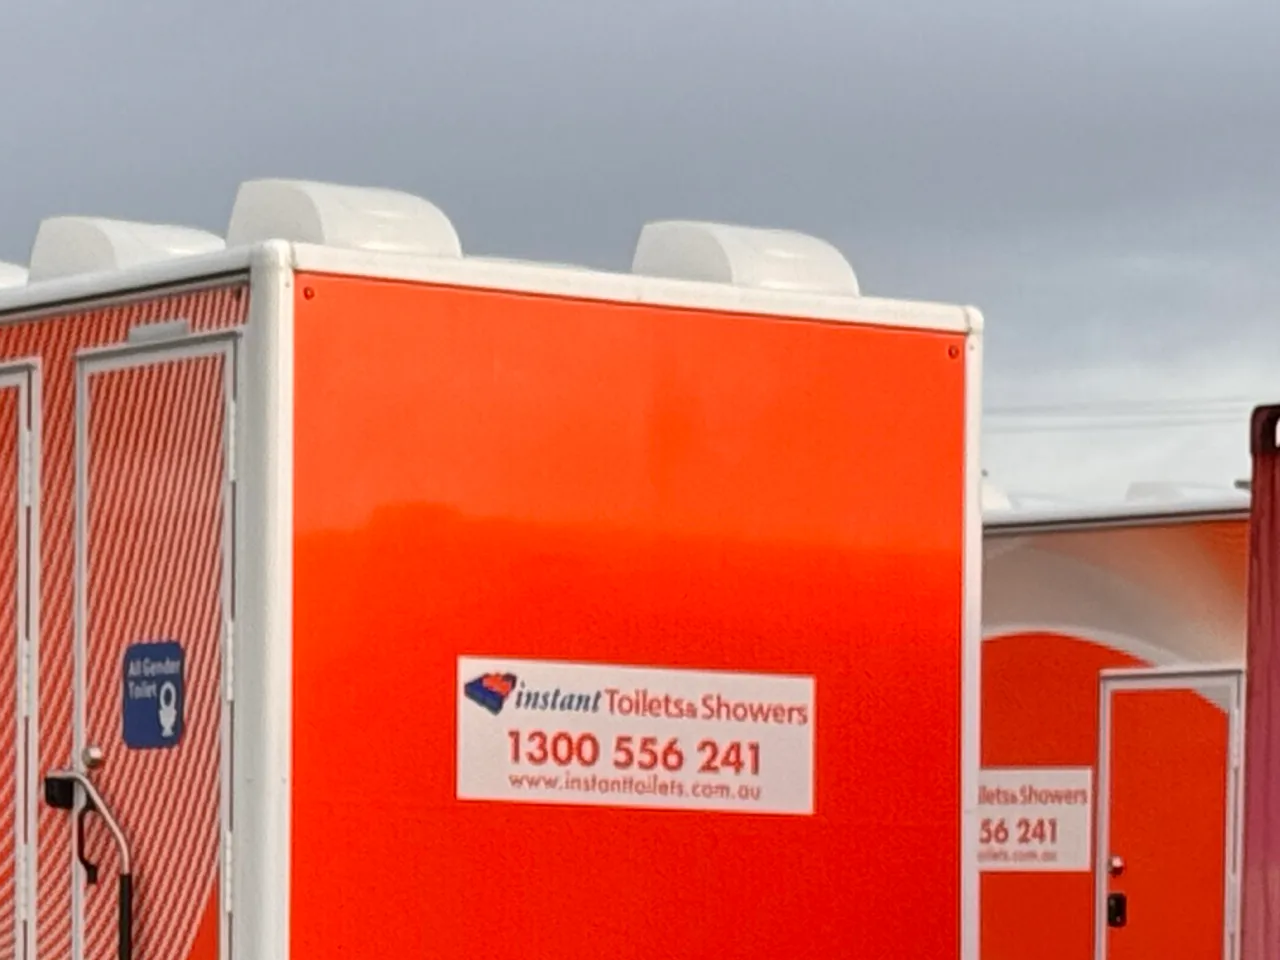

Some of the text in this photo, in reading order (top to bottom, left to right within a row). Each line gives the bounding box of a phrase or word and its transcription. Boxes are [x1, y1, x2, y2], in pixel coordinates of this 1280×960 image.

[516, 679, 602, 713] instant
[508, 729, 761, 776] 1300 556 241
[508, 770, 762, 800] www.instanttoilets.com.au
[1016, 818, 1057, 845] 241
